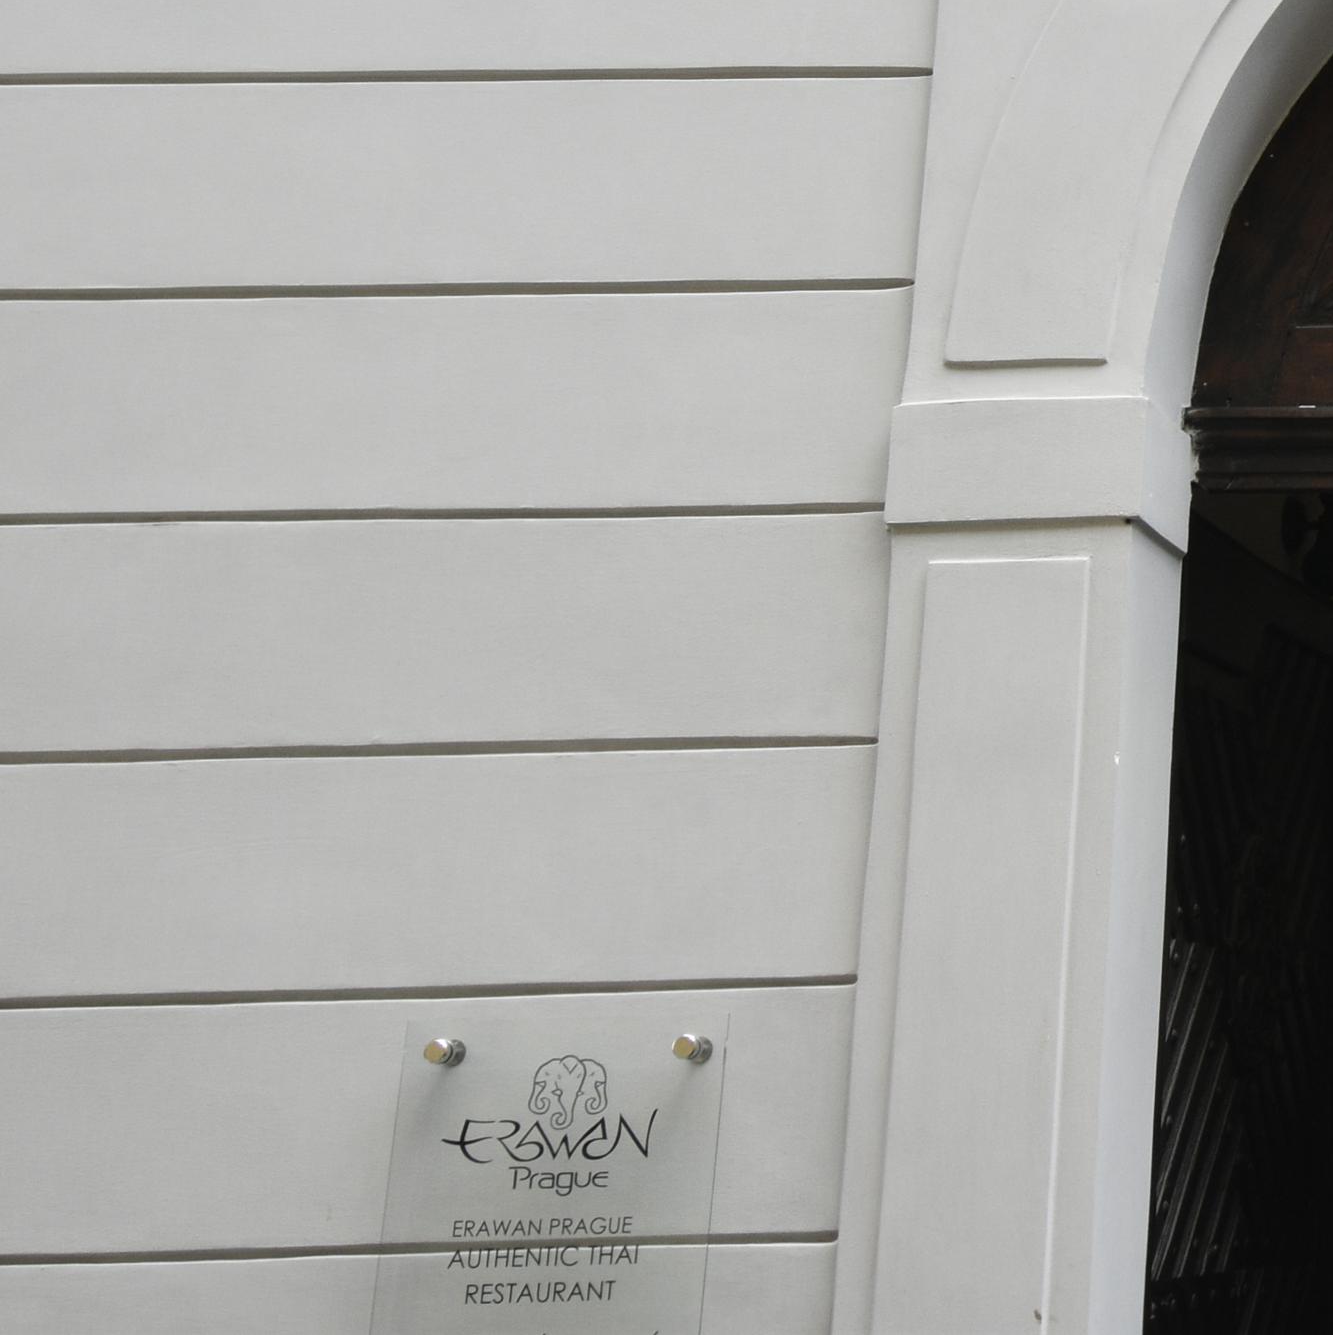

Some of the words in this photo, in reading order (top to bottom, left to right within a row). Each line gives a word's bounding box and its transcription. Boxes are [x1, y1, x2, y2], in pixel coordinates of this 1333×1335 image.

[441, 1109, 658, 1163] ERAWAN
[508, 1166, 609, 1196] Prague
[452, 1220, 542, 1237] ERAWAN
[549, 1217, 632, 1235] PRAGUE
[448, 1246, 579, 1268] AUTHENTIC
[588, 1245, 639, 1265] THAI
[465, 1280, 616, 1304] RESTAURANT
